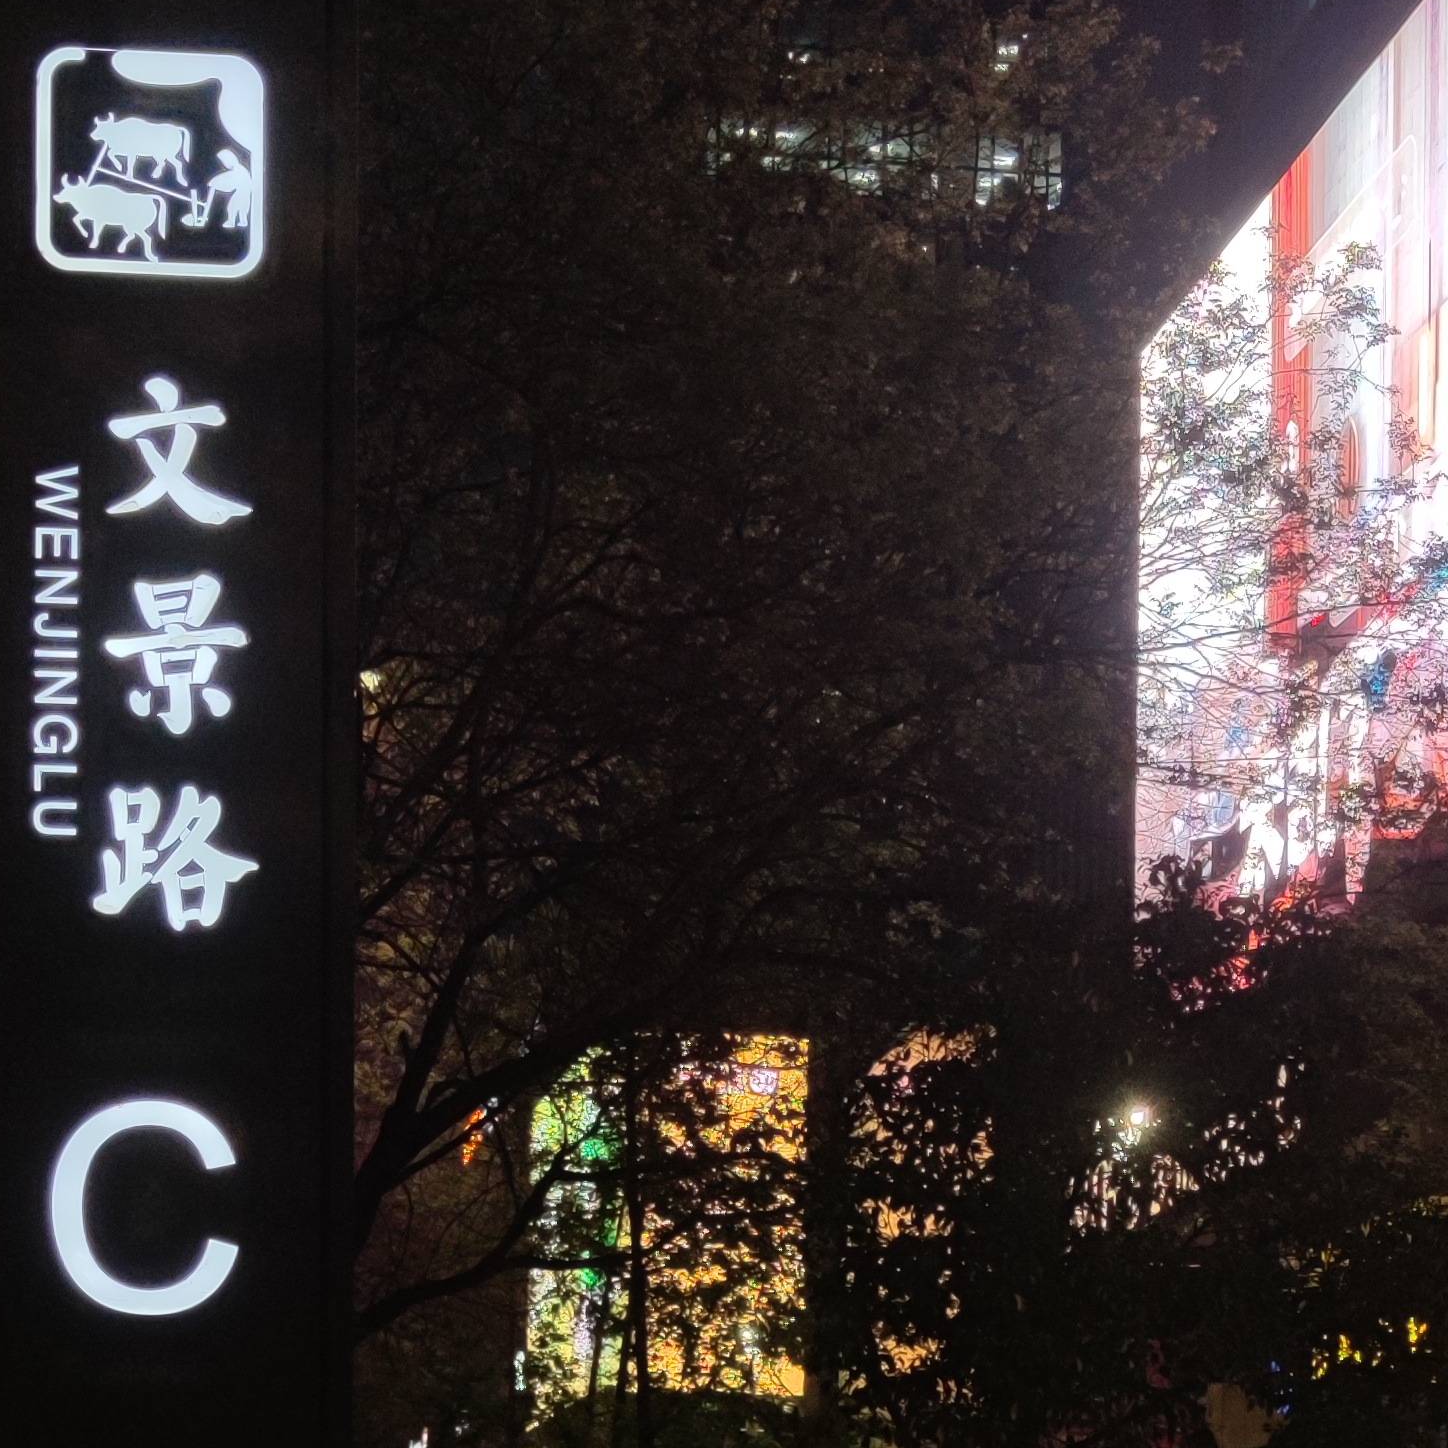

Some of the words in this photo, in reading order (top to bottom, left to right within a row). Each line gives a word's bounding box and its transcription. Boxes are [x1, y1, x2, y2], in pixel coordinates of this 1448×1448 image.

[93, 377, 259, 932] 文景路
[48, 1099, 239, 1316] C
